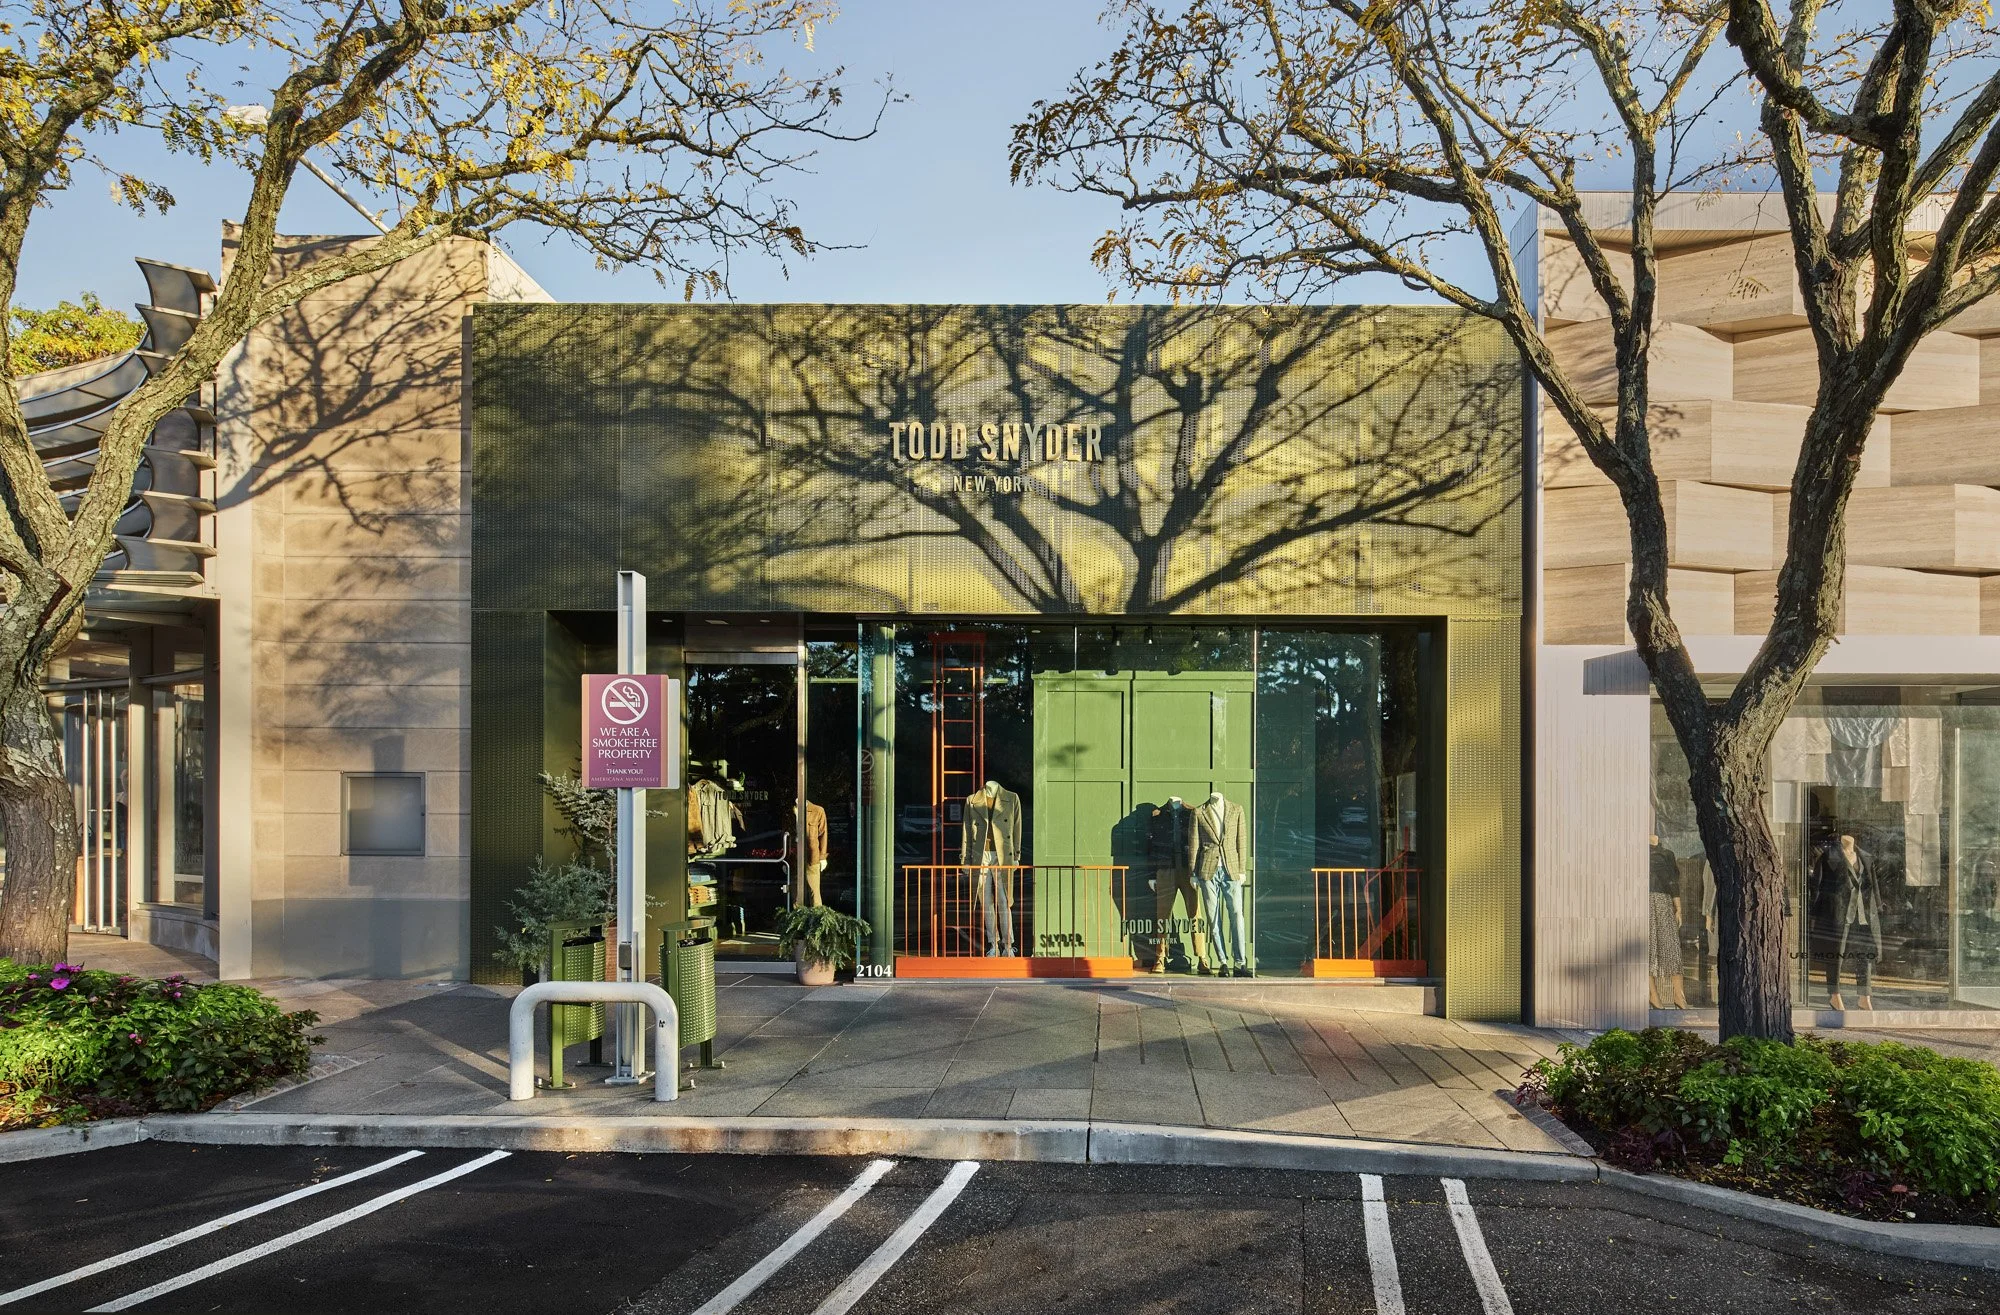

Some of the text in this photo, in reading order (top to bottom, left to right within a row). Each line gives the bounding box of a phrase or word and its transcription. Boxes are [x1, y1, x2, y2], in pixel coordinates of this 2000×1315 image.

[889, 422, 1102, 461] TODD SNYDER
[953, 475, 1033, 492] NEW YORK
[600, 727, 650, 736] WE ARE A
[592, 738, 658, 748] SMOKE-FREE
[598, 749, 652, 759] PROPERTY
[739, 790, 769, 801] SNYDER
[1121, 918, 1206, 935] TODD SNYDER
[1148, 937, 1161, 945] NEW
[1814, 952, 1877, 960] MONACO
[856, 964, 892, 978] 2104
